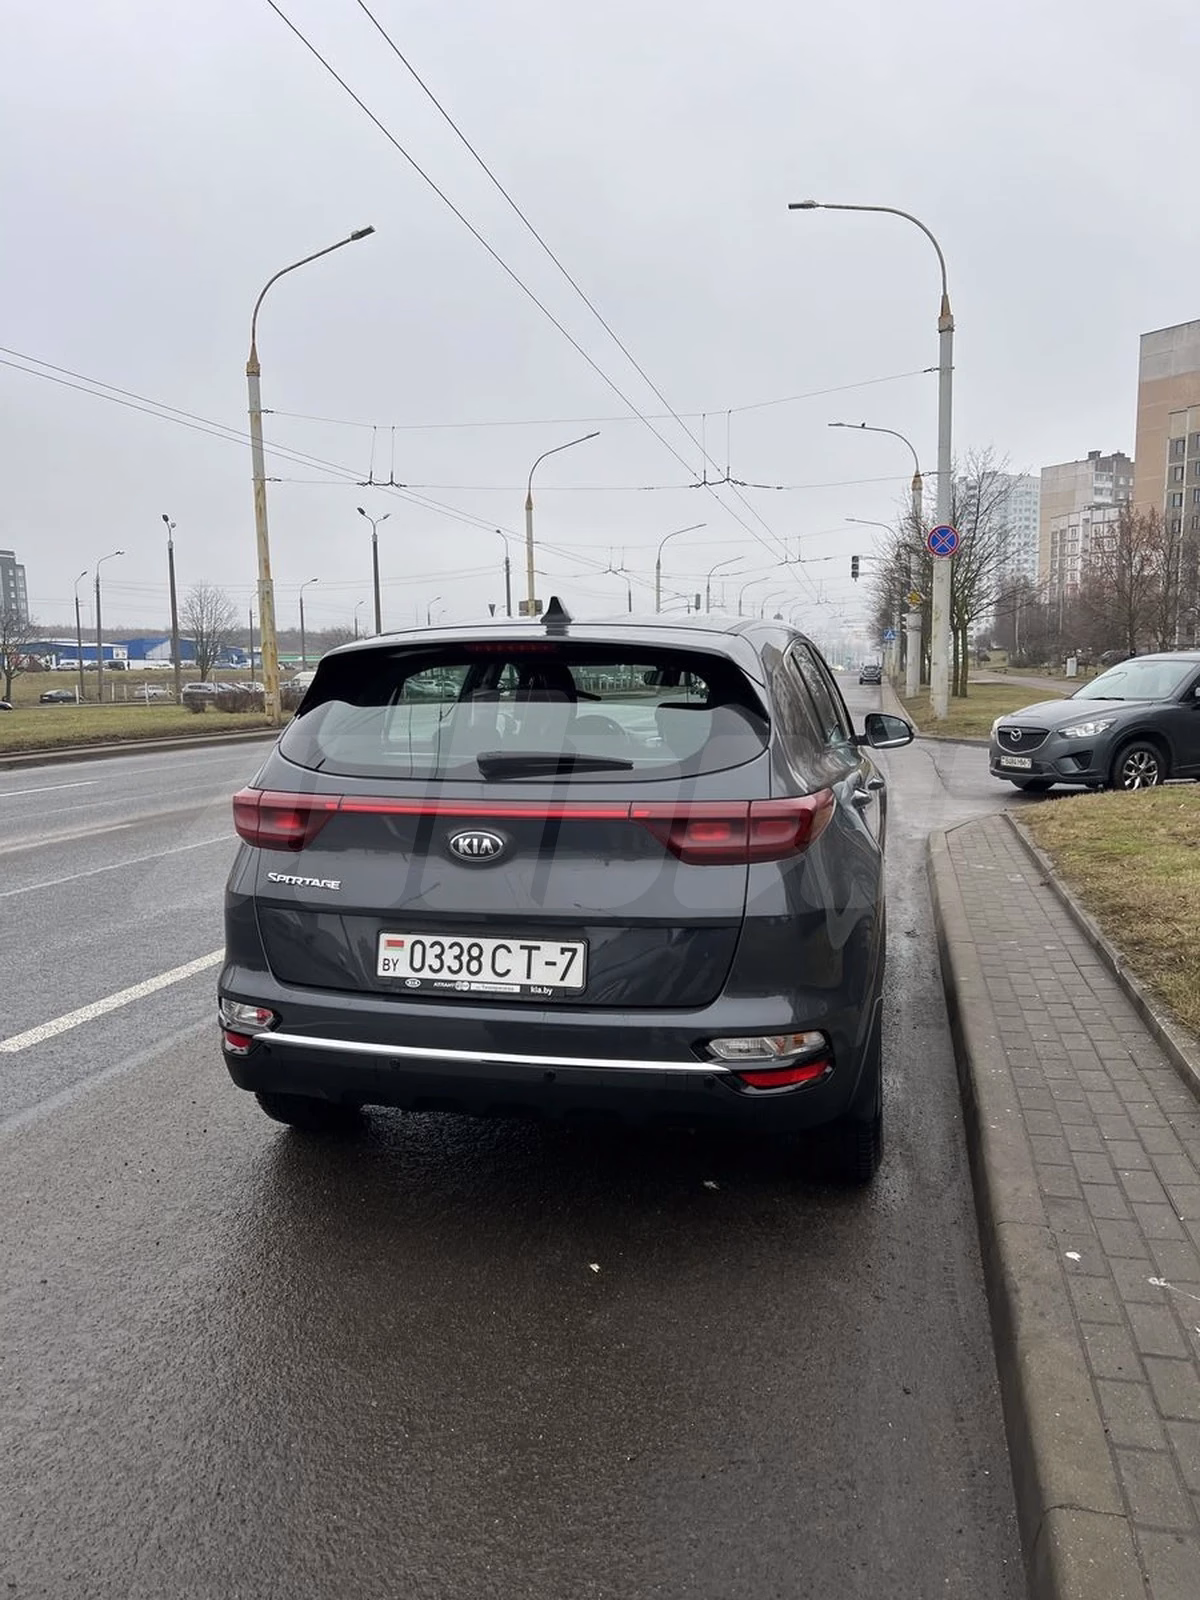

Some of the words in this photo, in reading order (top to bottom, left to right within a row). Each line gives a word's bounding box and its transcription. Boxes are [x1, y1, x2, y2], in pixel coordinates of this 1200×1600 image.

[458, 838, 494, 854] KIA
[267, 872, 341, 890] SPORTAGE
[382, 958, 399, 972] BY
[530, 985, 553, 996] kia.by
